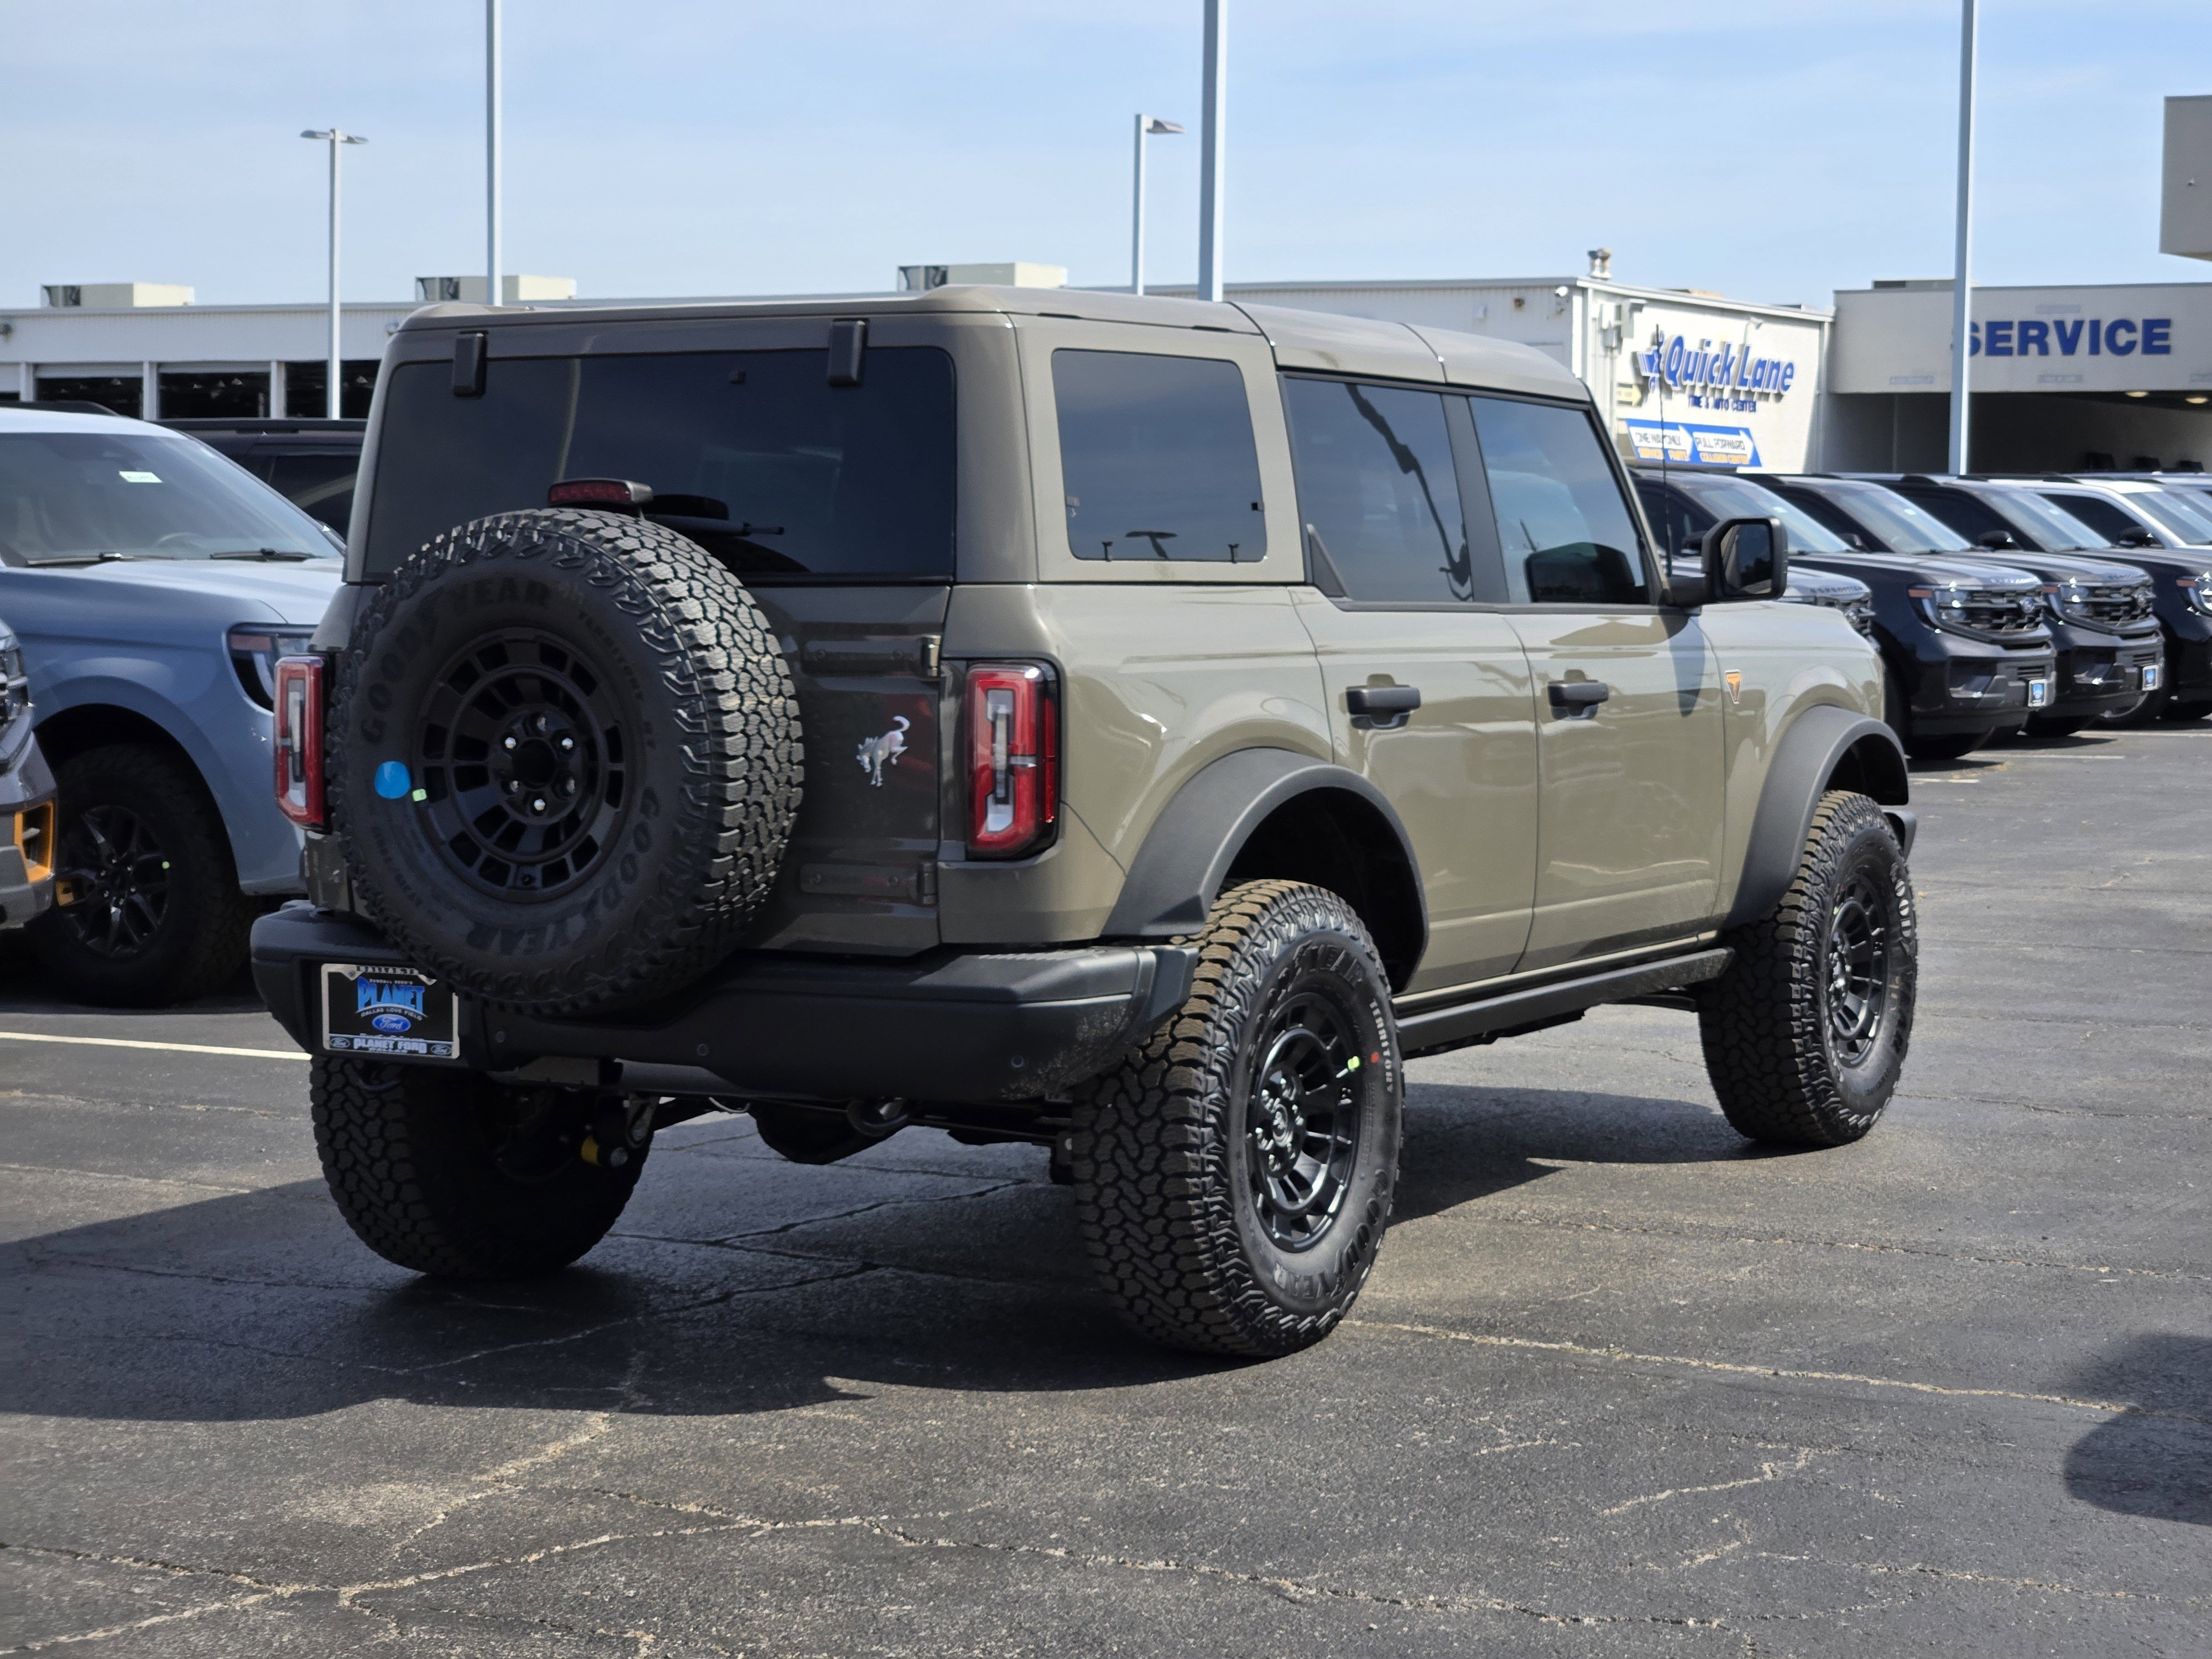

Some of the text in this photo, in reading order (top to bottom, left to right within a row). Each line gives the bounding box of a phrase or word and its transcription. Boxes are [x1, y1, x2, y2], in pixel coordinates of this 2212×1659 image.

[1665, 334, 1795, 393] Quick Lane
[1695, 437, 1714, 448] PULL
[357, 976, 425, 1013] PLANET
[375, 1015, 406, 1030] Ford
[353, 1037, 395, 1050] PLANET
[397, 1040, 427, 1055] FORD
[1369, 998, 1393, 1093] TERRITORY
